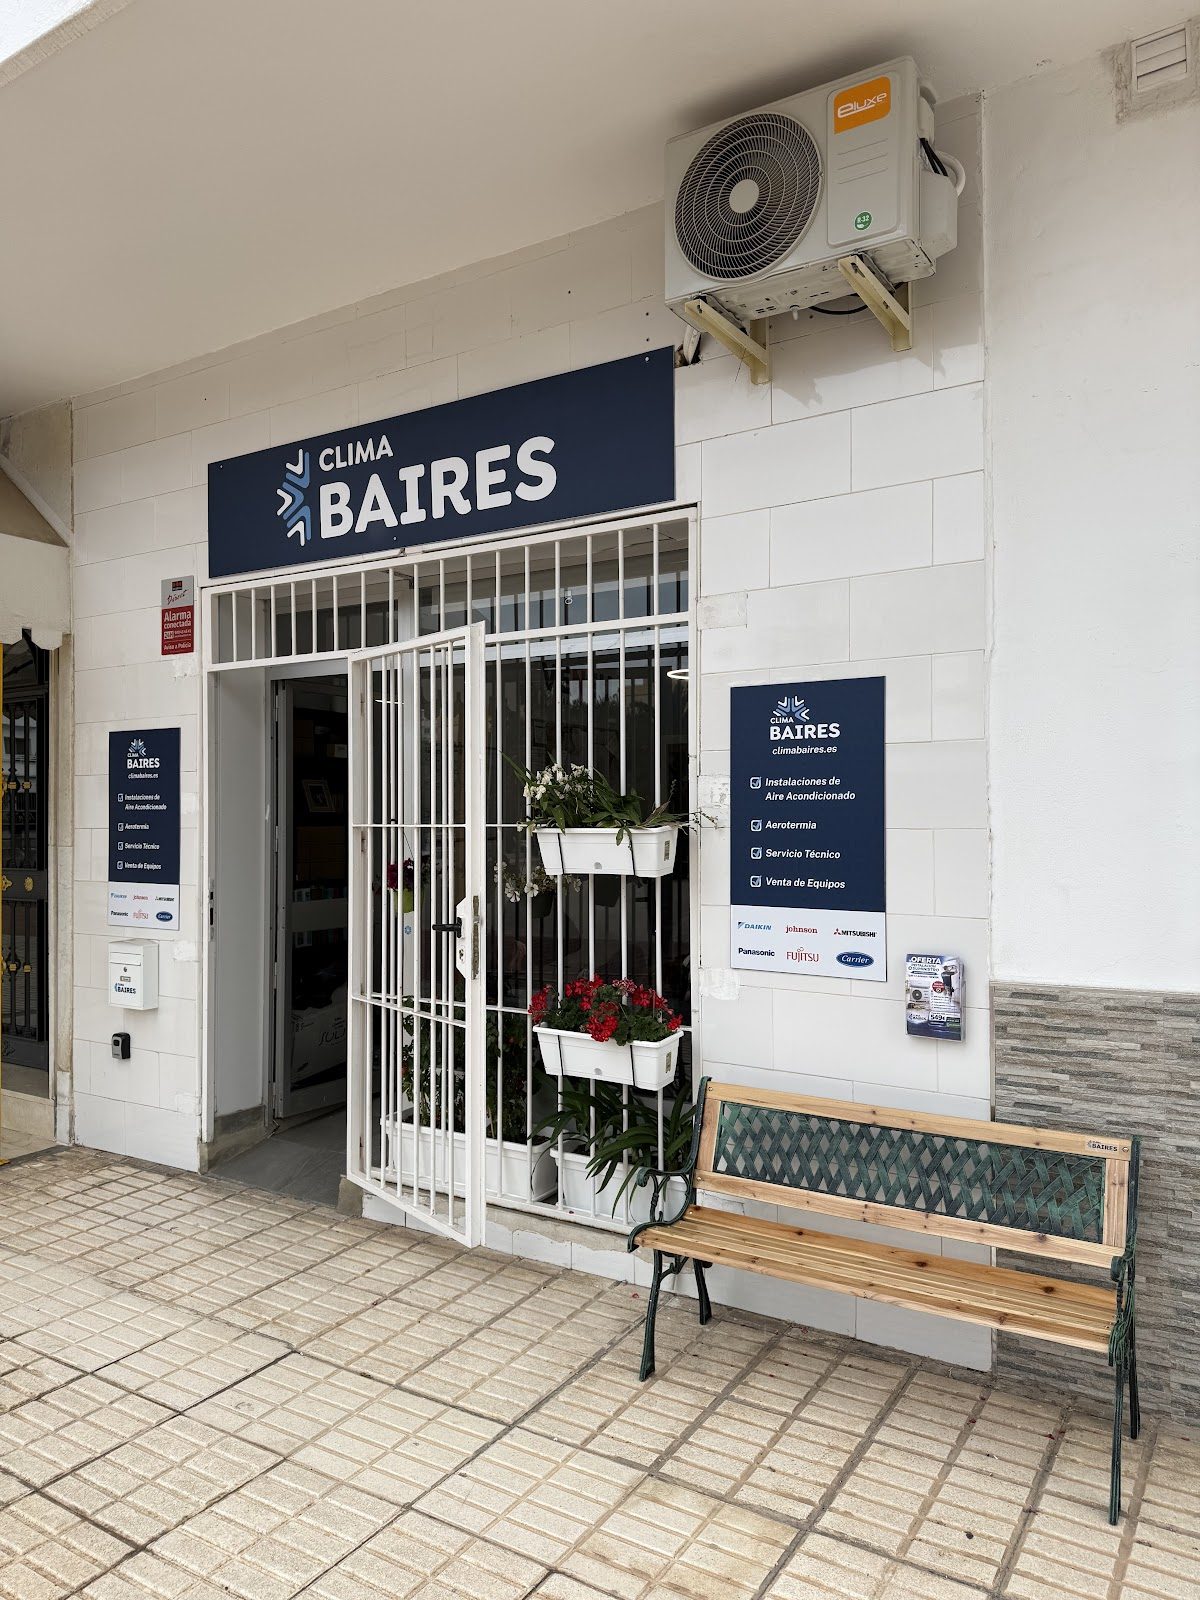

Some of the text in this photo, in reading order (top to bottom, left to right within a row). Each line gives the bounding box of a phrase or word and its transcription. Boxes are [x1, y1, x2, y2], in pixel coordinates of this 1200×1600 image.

[837, 92, 887, 118] eluxe
[318, 434, 394, 472] CLIMA
[319, 436, 558, 540] BAIRES
[164, 610, 192, 622] Alarma
[164, 619, 192, 629] conectada
[769, 716, 794, 724] CLIMA
[769, 722, 841, 741] BAIRES
[772, 745, 838, 756] climabaires.es
[126, 757, 161, 769] BAIRES
[765, 776, 841, 787] Instalaciones de
[124, 793, 161, 801] Instalaciones de
[765, 790, 856, 801] Aire Acondicionado
[134, 803, 168, 811] Acondicionado
[765, 820, 817, 830] Aerotermia
[142, 842, 160, 850] Técnico
[765, 848, 841, 860] Servicio Técnico
[143, 862, 162, 870] Equipos
[765, 877, 846, 890] Venta de Equipos
[744, 923, 877, 938] DAIKIN johnson MITSUBISHI
[738, 947, 870, 965] Panasonic FUJITSU Carrier
[912, 956, 941, 964] OFERTA
[117, 986, 137, 994] BAIRES
[1092, 1144, 1118, 1152] BAIRES
